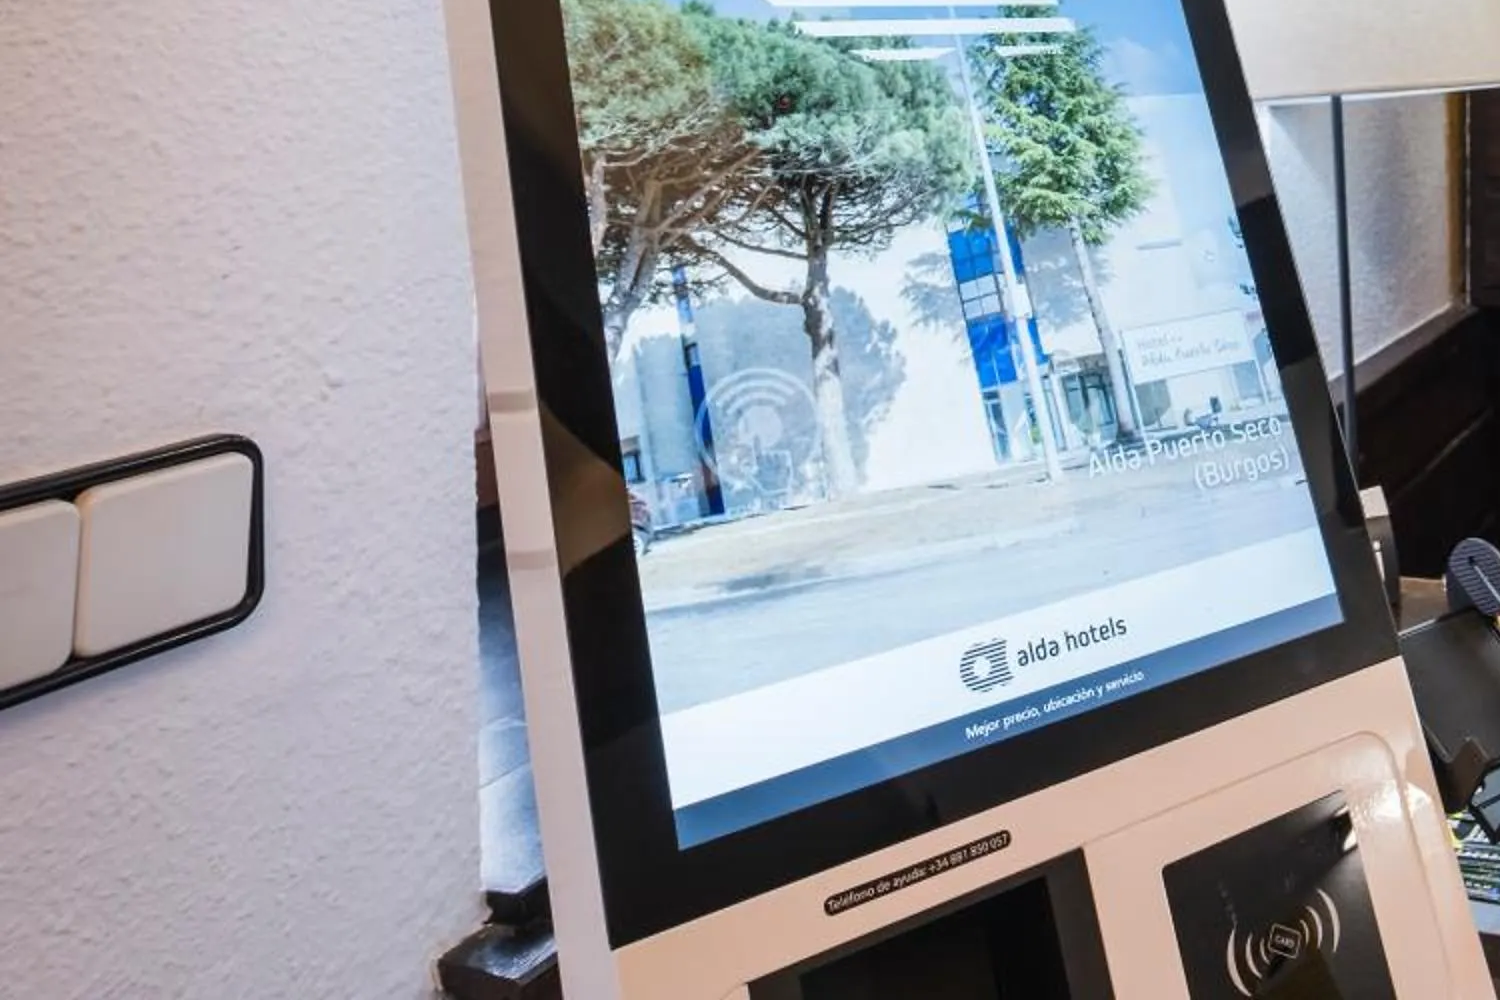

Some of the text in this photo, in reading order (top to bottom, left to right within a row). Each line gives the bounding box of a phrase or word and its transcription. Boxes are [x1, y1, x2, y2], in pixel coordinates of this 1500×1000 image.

[1088, 415, 1282, 480] Alda Puerto Seco
[1194, 443, 1291, 489] (Burgos)
[1016, 616, 1128, 667] alda hotels
[965, 718, 1001, 740] Mejor
[1002, 706, 1041, 731] precio,
[1043, 686, 1096, 713] ubicación
[1105, 671, 1145, 691] servicio
[828, 887, 874, 911] Teléfono
[876, 879, 891, 893] de
[927, 857, 950, 873] +34
